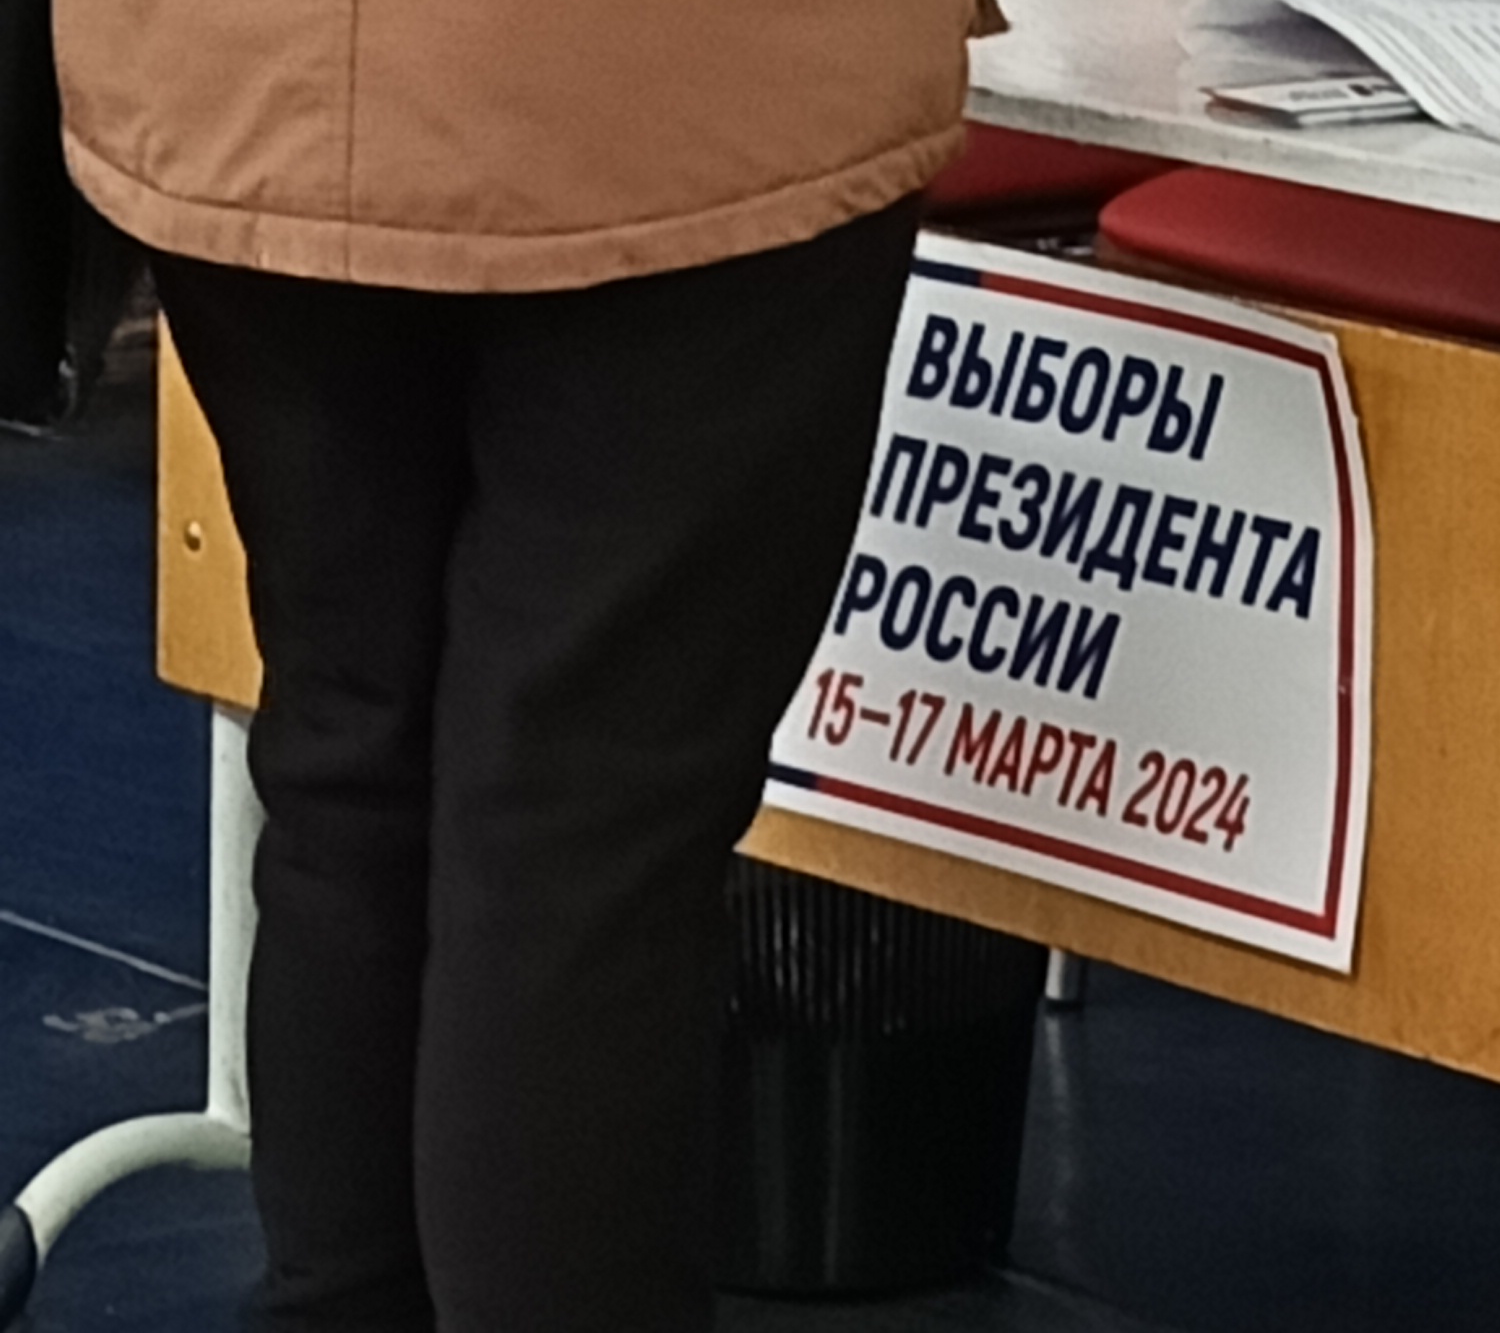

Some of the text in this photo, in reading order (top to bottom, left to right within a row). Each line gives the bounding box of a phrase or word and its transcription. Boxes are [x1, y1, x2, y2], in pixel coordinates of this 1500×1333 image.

[906, 313, 1225, 461] ВЫБОРЫ
[868, 433, 1322, 620] ПРЕЗИДЕНТА
[832, 552, 1121, 700] РОССИИ
[944, 701, 1118, 818] МАРТА
[1122, 750, 1252, 852] 2024
